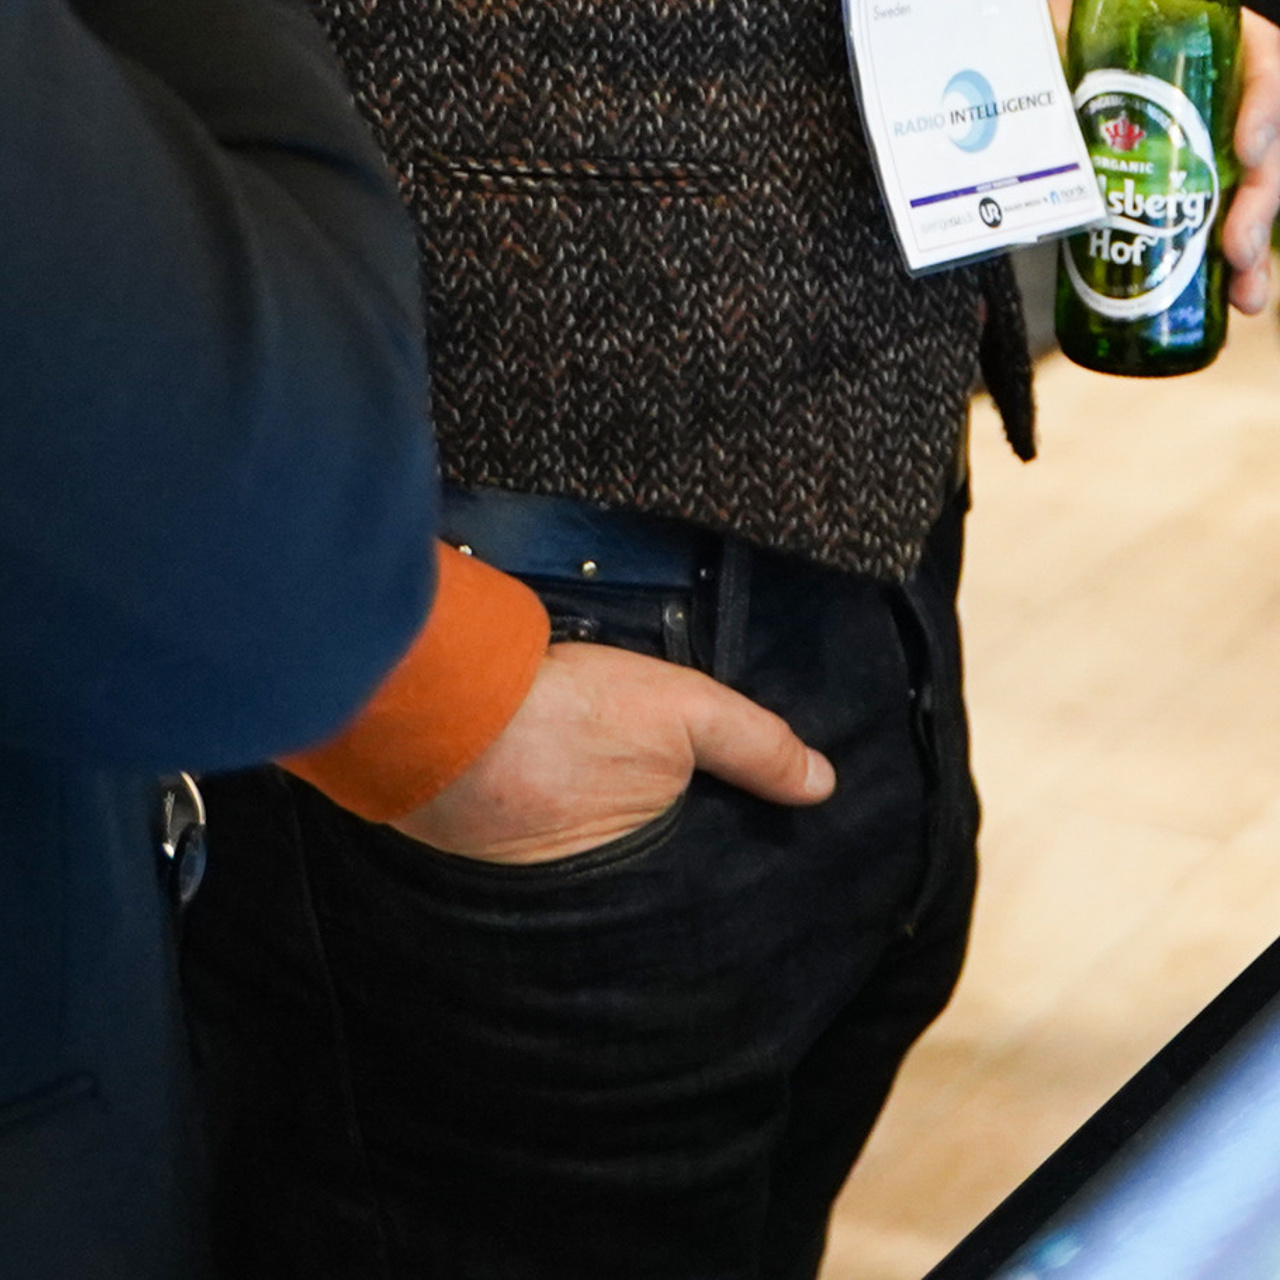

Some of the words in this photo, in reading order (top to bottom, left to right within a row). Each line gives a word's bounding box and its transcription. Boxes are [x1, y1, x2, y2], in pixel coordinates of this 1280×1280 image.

[874, 2, 911, 20] Sweden
[893, 113, 945, 137] RADIO
[1093, 155, 1155, 175] ORGANIC
[1089, 228, 1159, 267] Hof
